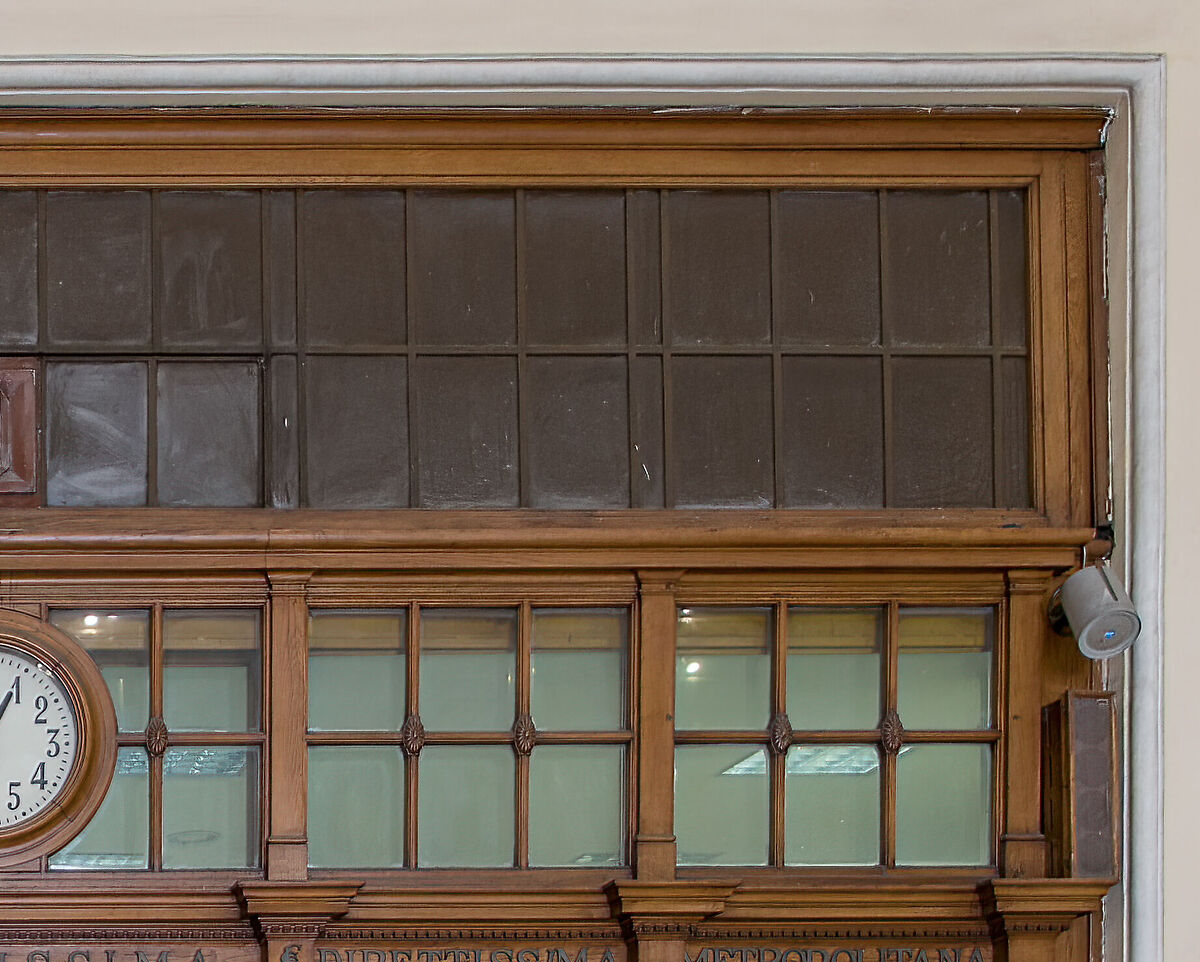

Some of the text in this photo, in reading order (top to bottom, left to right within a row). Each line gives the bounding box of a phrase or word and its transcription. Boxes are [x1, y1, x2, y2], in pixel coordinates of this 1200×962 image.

[11, 676, 21, 704] 1
[35, 695, 48, 724] 2
[47, 729, 60, 757] 3
[31, 762, 48, 790] 4
[7, 782, 21, 810] 5
